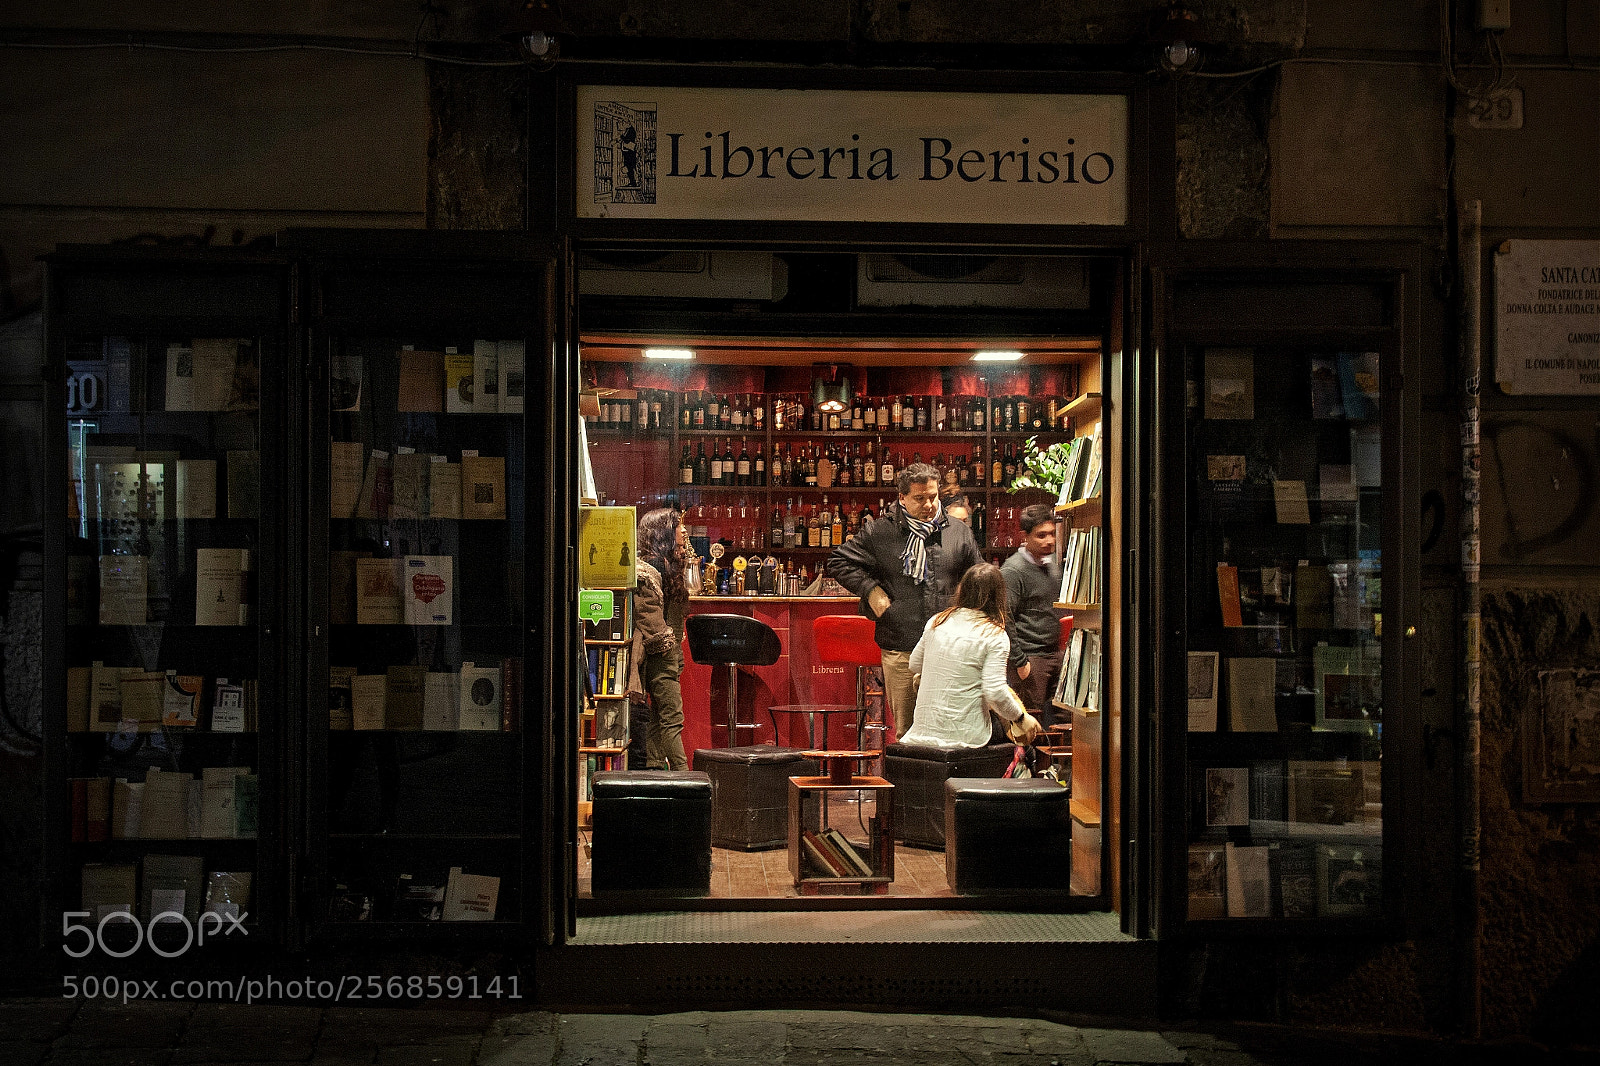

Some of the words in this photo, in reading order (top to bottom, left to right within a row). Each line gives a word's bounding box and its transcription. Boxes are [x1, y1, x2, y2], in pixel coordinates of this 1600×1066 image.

[665, 130, 899, 183] Libreria
[919, 136, 1115, 186] Berisio
[1541, 266, 1578, 284] SANTA
[1538, 289, 1583, 300] FONDATRICE
[1506, 303, 1533, 314] DONNA
[1534, 304, 1557, 315] COLTA
[1565, 304, 1594, 315] AUDACE
[1533, 358, 1566, 370] COMUNE
[1567, 359, 1575, 370] DI
